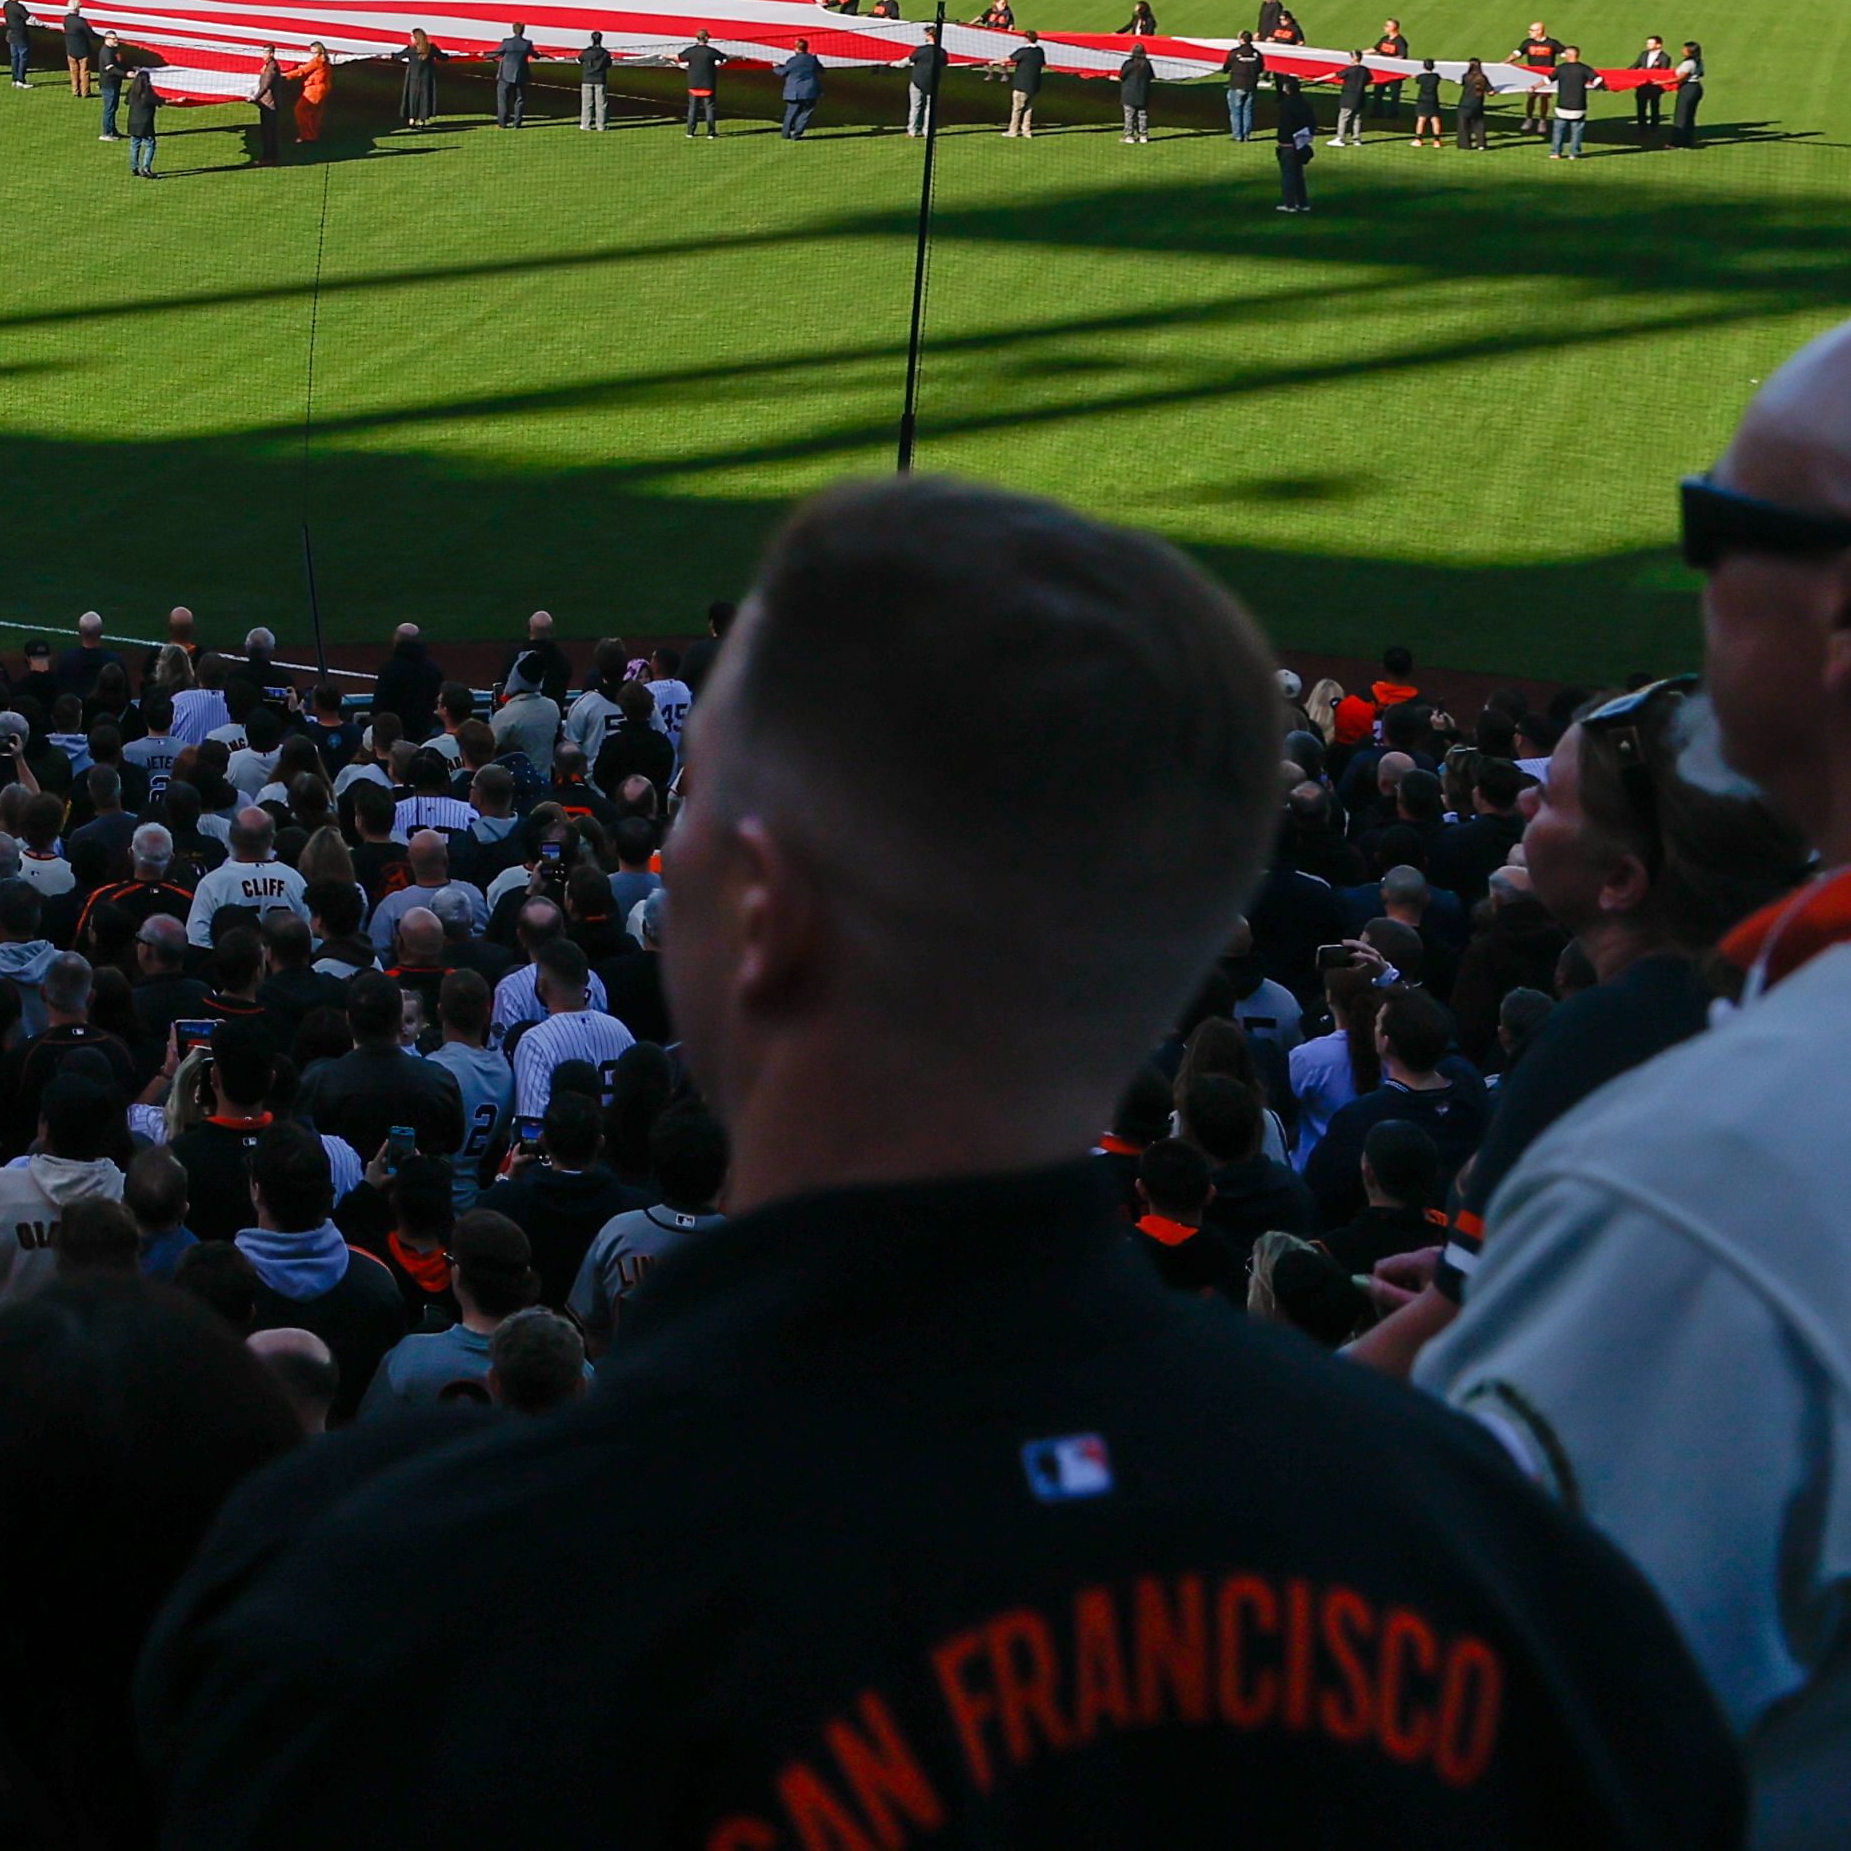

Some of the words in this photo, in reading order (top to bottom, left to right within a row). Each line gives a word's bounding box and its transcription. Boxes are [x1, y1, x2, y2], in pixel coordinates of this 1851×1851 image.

[146, 755, 174, 771] JETE
[241, 878, 286, 898] CLIFF
[463, 1101, 500, 1158] 2
[928, 1571, 1504, 1793] FRANCISCO
